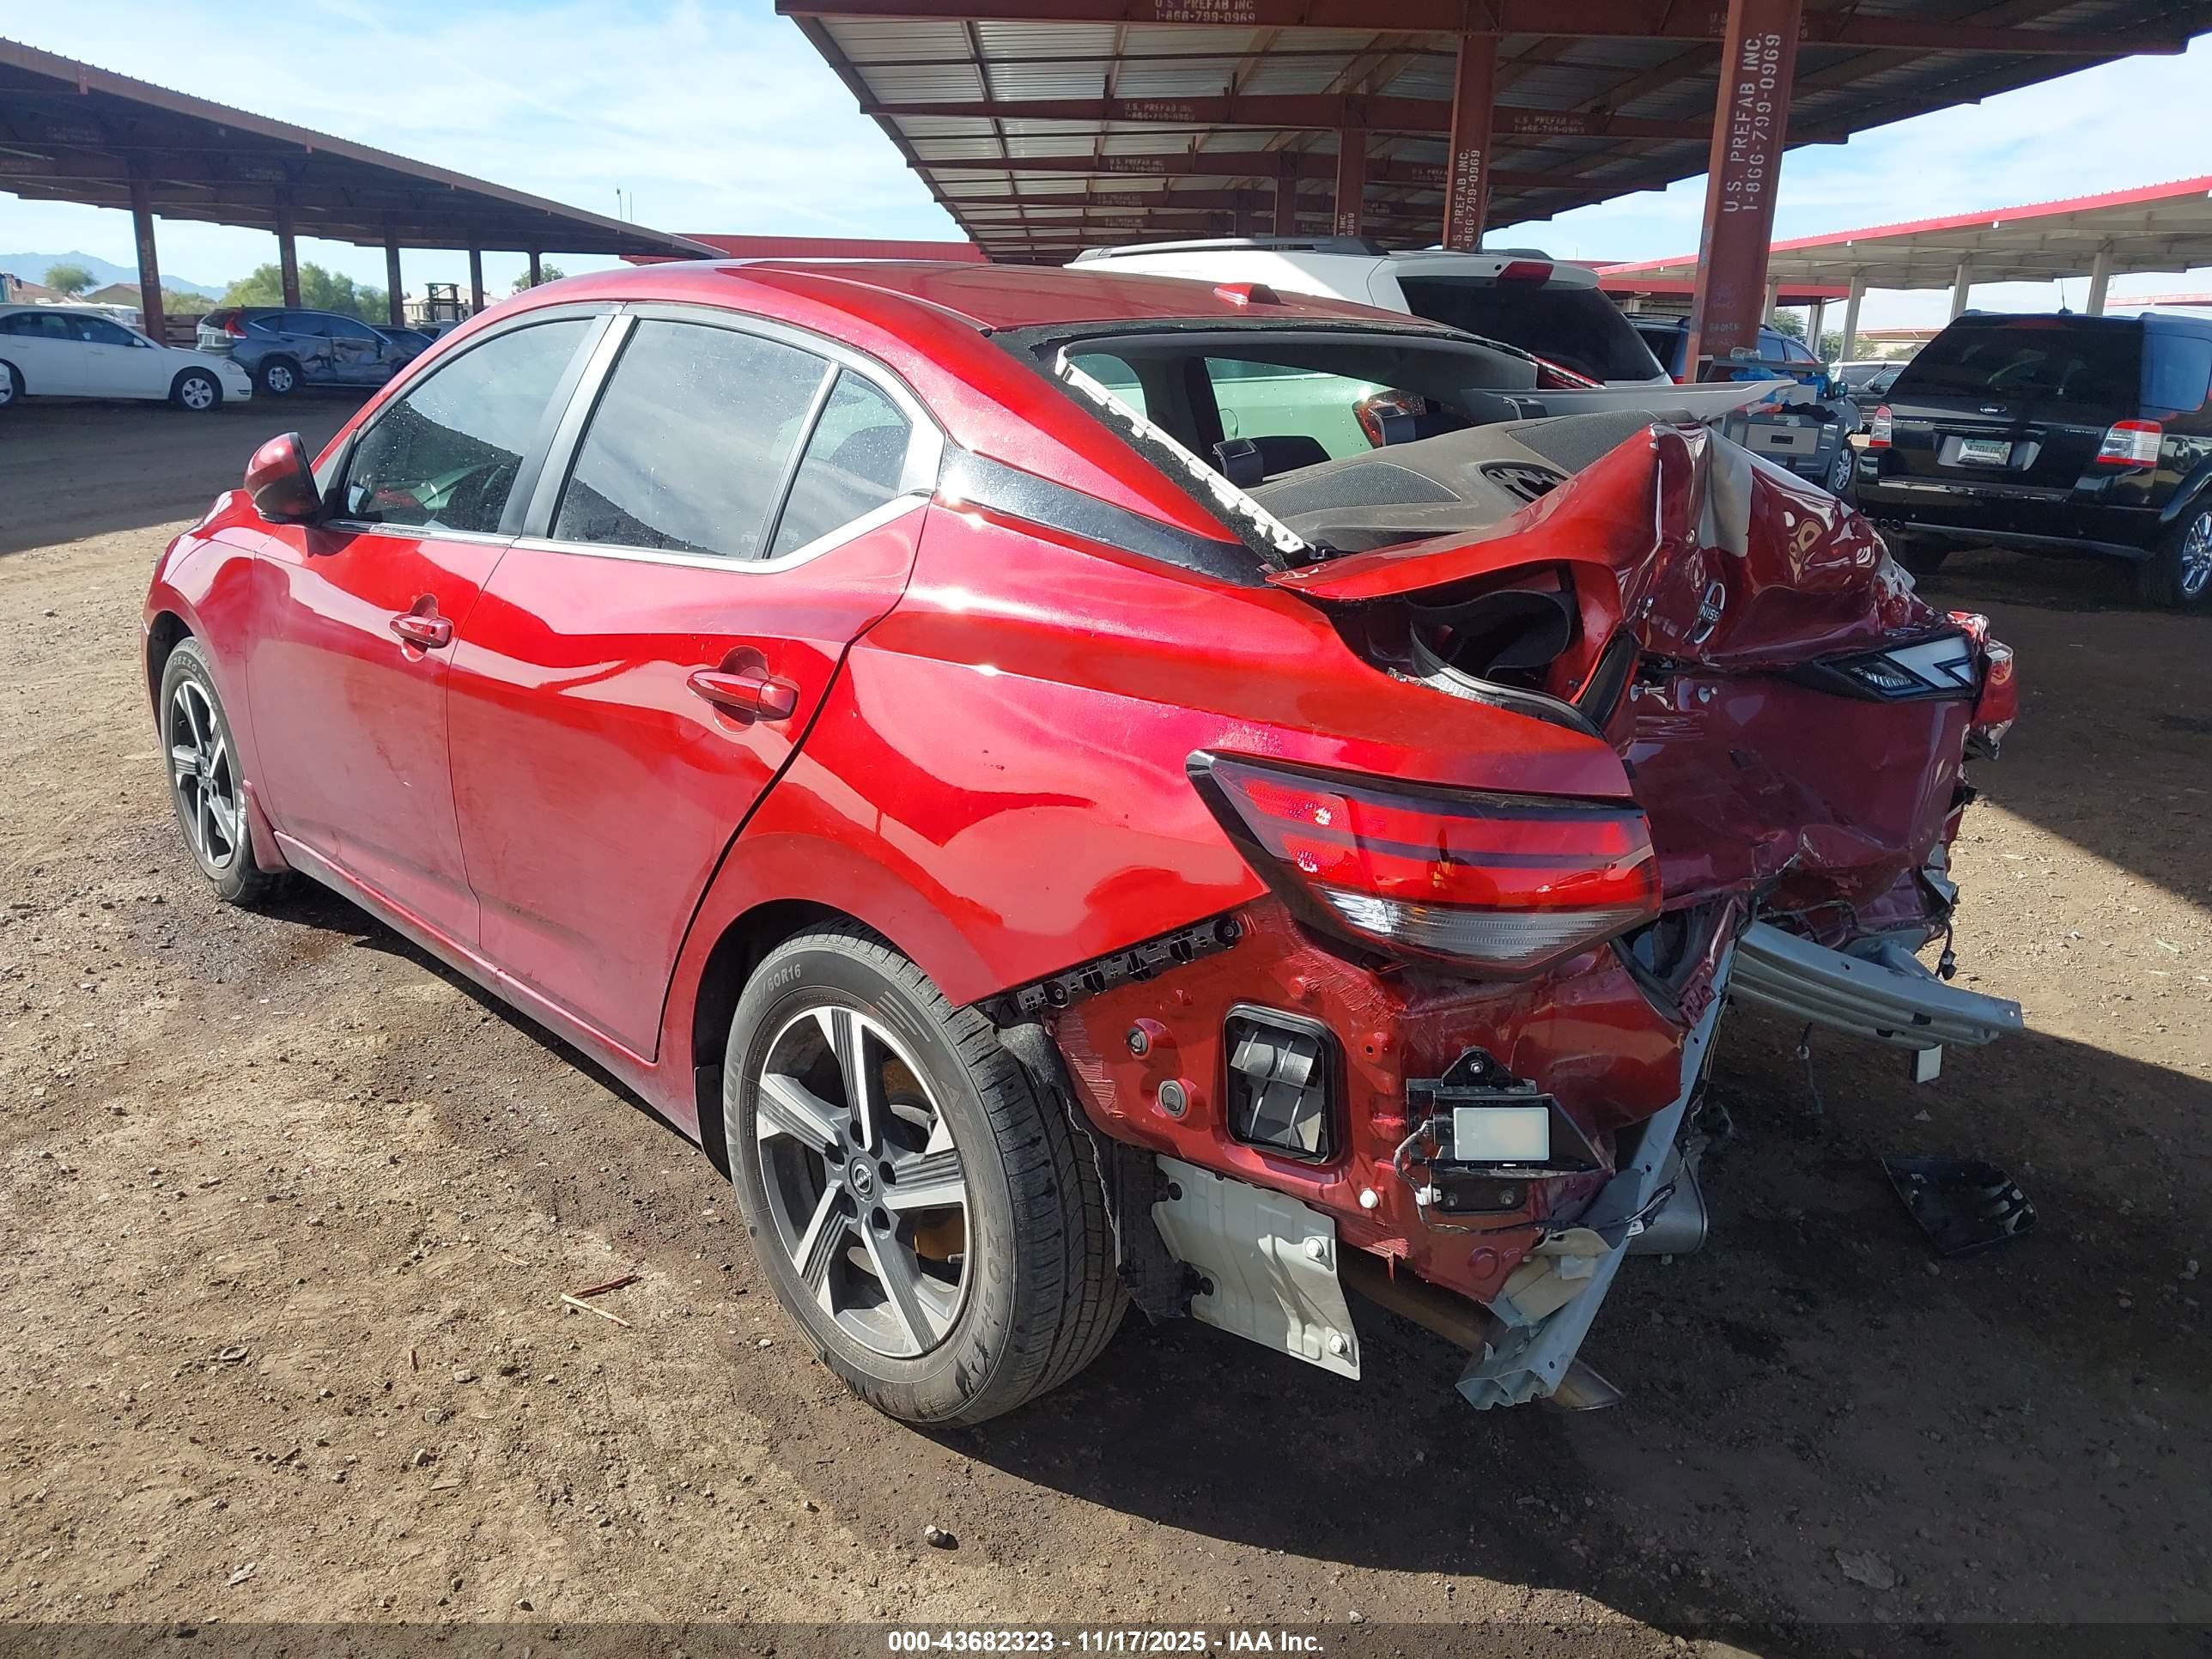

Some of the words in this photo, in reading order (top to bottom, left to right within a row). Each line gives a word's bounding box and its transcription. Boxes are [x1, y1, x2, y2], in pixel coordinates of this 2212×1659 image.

[1155, 9, 1256, 22] 1-866-799-0969
[1183, 0, 1229, 9] PREFAB
[1742, 32, 1763, 71] INC.
[1729, 82, 1756, 162] PREFAB
[1742, 33, 1781, 210] 1-866-799-0969
[1457, 149, 1470, 172] INC.
[1454, 178, 1467, 224] PREFAB
[1723, 174, 1744, 213] U.S.
